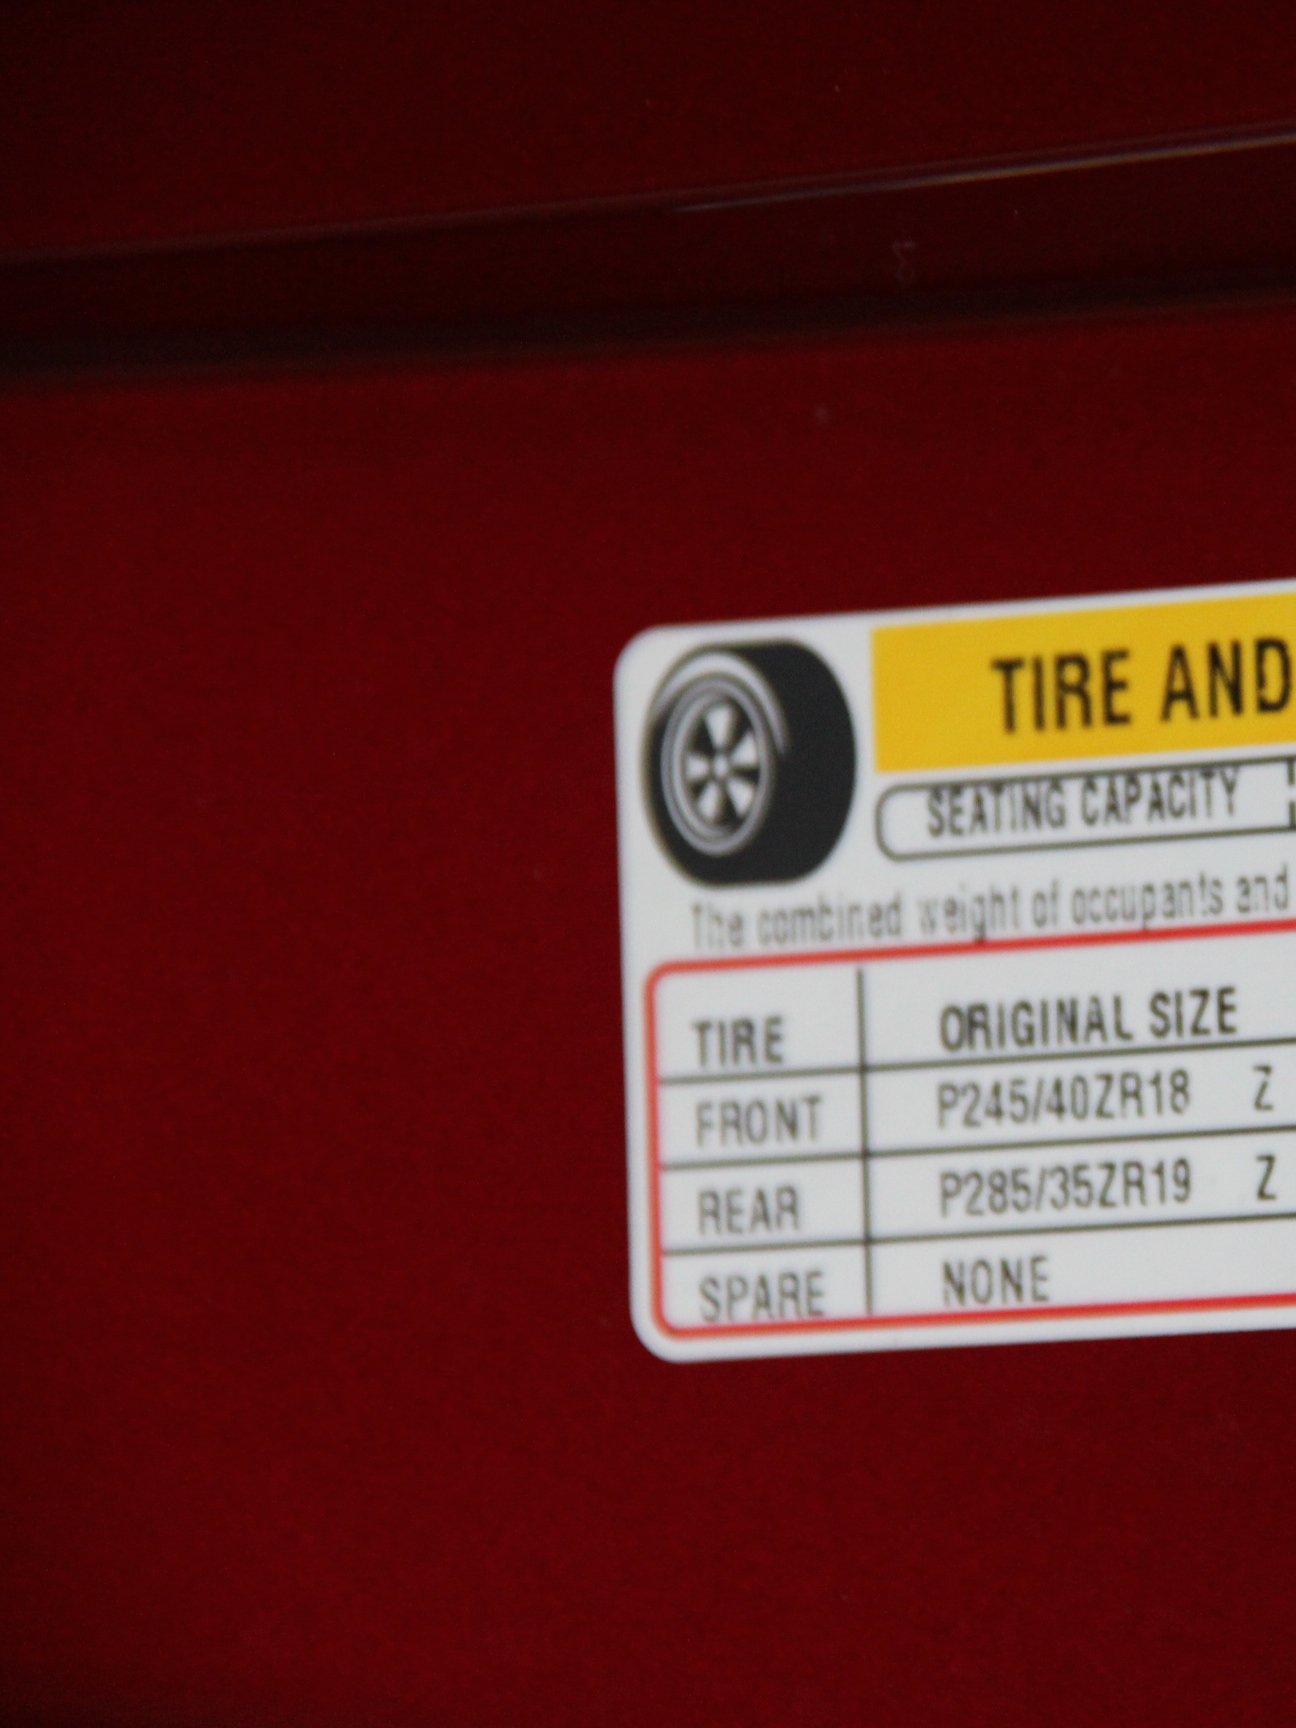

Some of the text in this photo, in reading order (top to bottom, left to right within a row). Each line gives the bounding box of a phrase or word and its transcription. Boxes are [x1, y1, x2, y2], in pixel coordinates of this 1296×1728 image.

[992, 649, 1131, 734] TIRE
[1160, 637, 1293, 723] AND
[926, 768, 1241, 837] SEATING CAPACITY
[692, 903, 744, 949] The
[757, 889, 901, 945] combined
[918, 883, 1021, 943] weight
[1033, 878, 1060, 925] of
[1072, 873, 1224, 931] occupants
[1236, 864, 1288, 914] and
[693, 1017, 784, 1068] TIRE
[940, 987, 1237, 1052] ORIGINAL SIZE
[696, 1096, 823, 1148] FRONT
[937, 1065, 1274, 1130] P245/40ZR18 Z
[698, 1185, 799, 1237] REAR
[940, 1155, 1277, 1219] P285/35ZR19 Z
[701, 1271, 825, 1323] SPARE
[944, 1255, 1050, 1307] NONE
